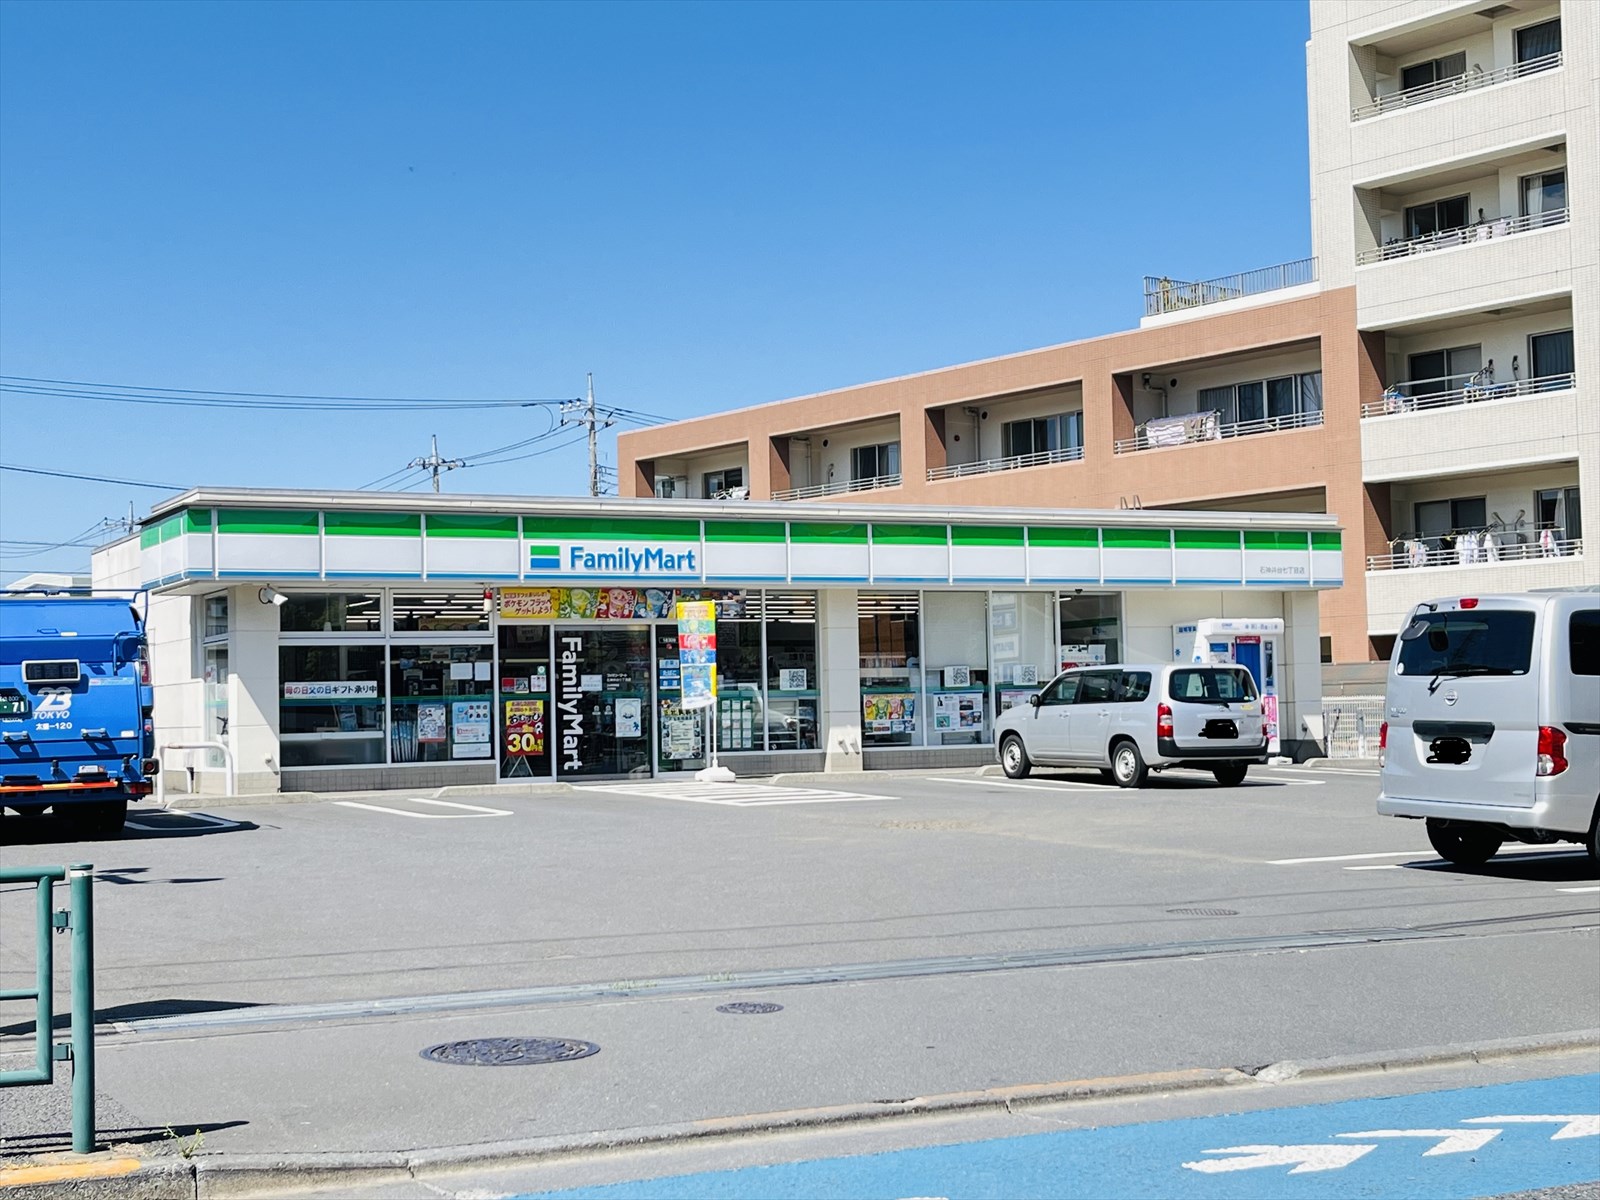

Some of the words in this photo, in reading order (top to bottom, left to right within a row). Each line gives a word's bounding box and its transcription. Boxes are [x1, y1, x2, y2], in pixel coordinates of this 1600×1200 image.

[570, 546, 696, 573] FamilyMart
[35, 686, 72, 711] 23
[285, 685, 377, 695] 母の日父の日ギフト承り中
[33, 711, 70, 720] TOKYO
[557, 637, 583, 770] FamilyMart
